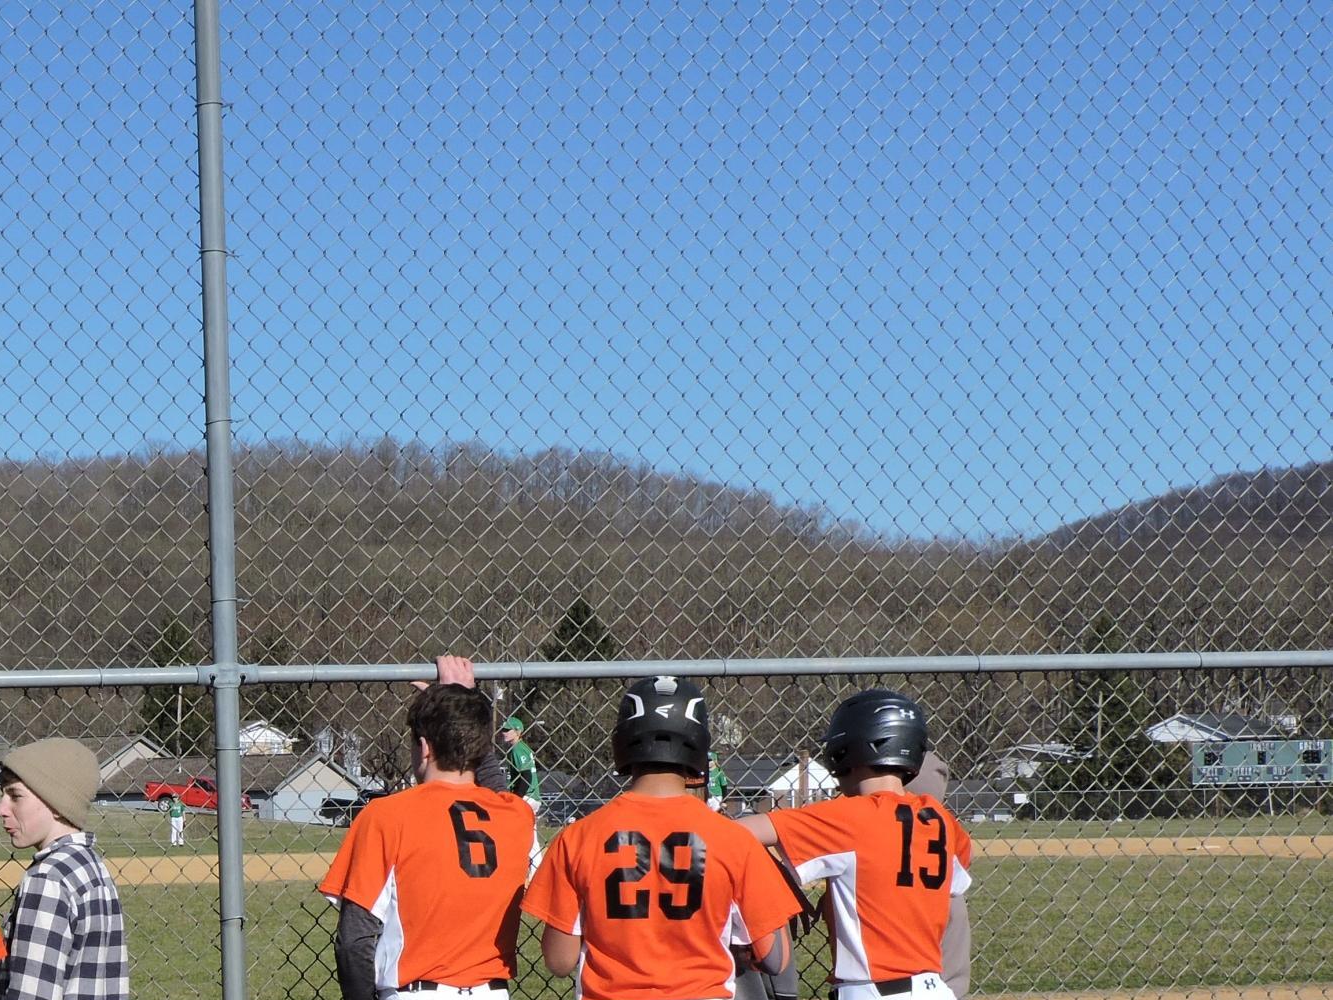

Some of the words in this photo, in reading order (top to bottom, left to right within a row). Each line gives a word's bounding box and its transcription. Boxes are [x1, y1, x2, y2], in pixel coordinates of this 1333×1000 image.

[448, 800, 498, 878] 6
[604, 831, 707, 920] 29
[894, 803, 948, 890] 13
